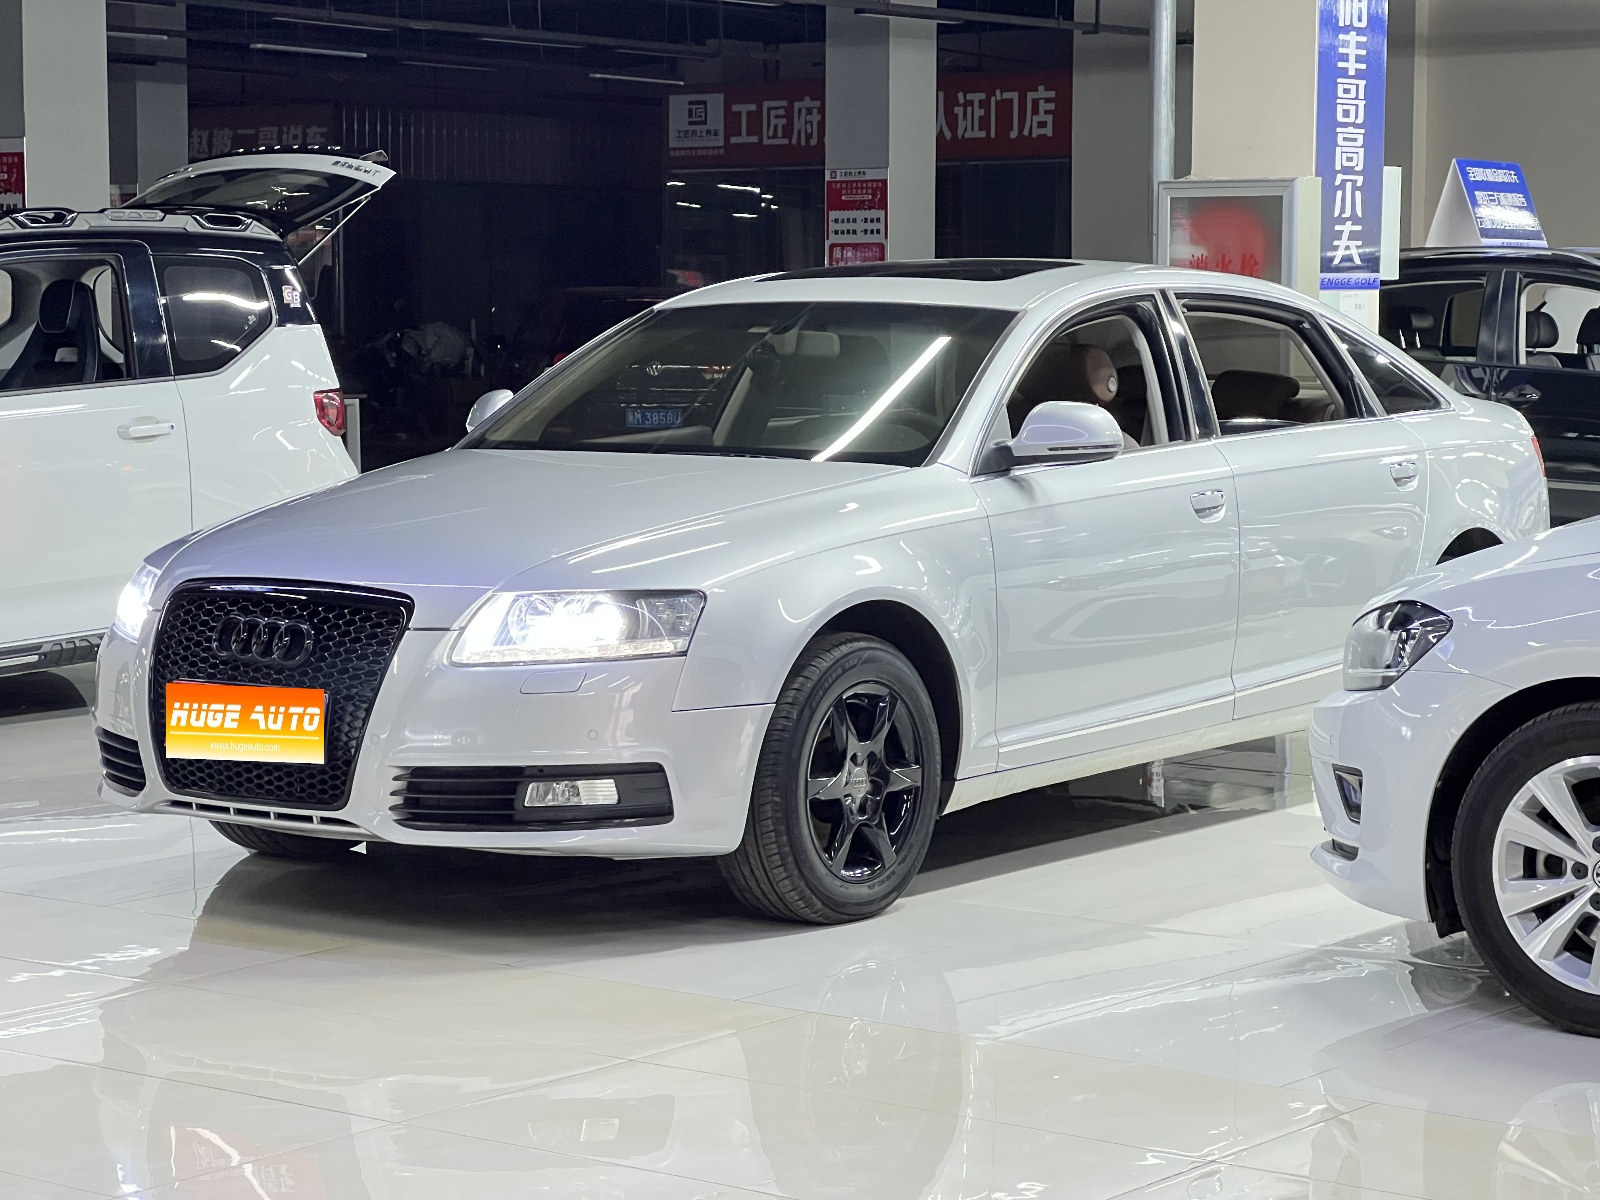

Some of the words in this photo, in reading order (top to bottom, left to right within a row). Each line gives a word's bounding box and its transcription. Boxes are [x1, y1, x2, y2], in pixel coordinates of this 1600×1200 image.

[730, 96, 821, 146] 工匠府
[1320, 277, 1352, 286] ENGGE
[1354, 277, 1378, 286] GOLF
